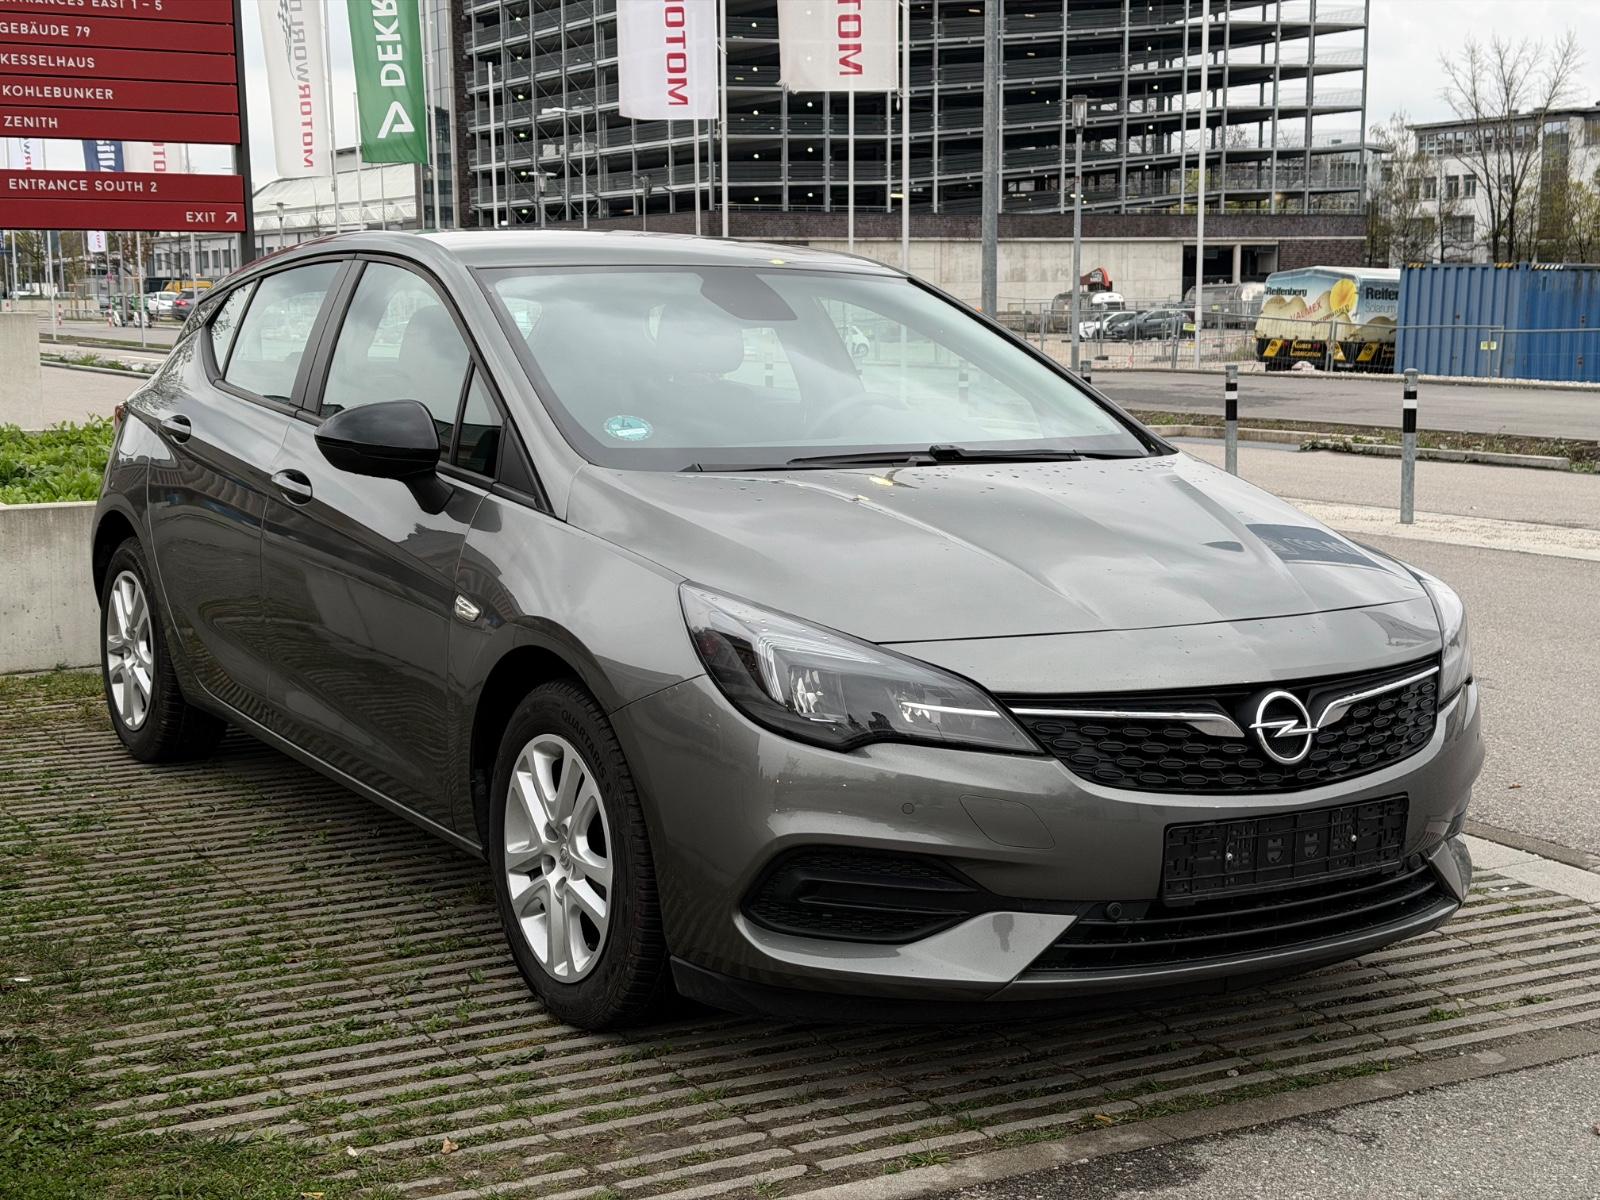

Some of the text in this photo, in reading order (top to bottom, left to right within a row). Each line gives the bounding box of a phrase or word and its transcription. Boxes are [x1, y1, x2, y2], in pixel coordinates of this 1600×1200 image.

[155, 0, 163, 11] 5
[0, 21, 91, 37] GEBÄUDE 79
[0, 53, 95, 68] KESSELHAUS
[2, 85, 113, 100] KOHLEBUNKER
[4, 116, 58, 128] ZENITH
[9, 178, 158, 193] ENTRANCE SOUTH 2
[186, 211, 216, 223] EXIT
